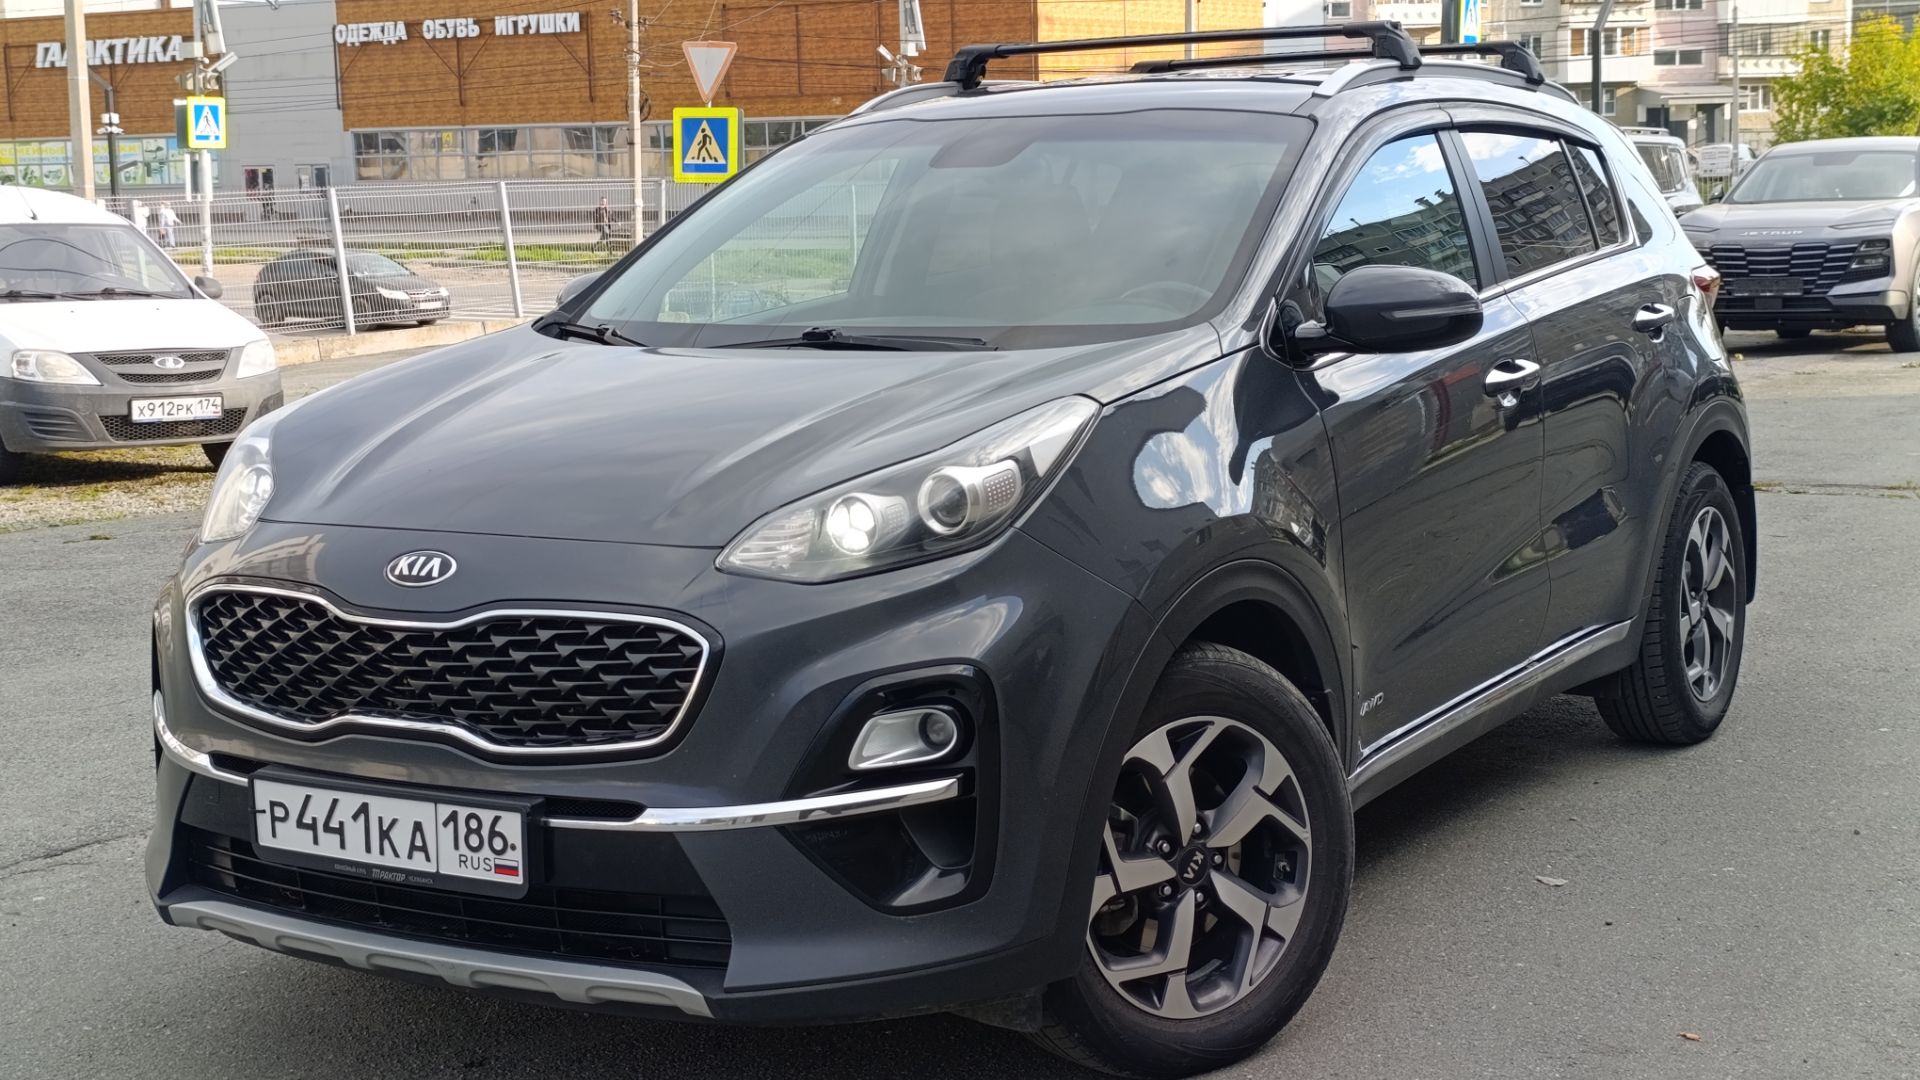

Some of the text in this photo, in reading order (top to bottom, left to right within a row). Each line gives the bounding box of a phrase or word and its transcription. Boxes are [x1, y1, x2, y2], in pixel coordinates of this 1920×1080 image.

[335, 12, 581, 46] ОДЕЖДА ОБУВЬ ИГРУШКИ
[137, 401, 193, 417] Х912РК
[197, 398, 220, 411] 174
[393, 555, 443, 579] KIA
[268, 793, 510, 863] Р441КА 186
[457, 853, 493, 873] RUS
[1183, 850, 1205, 880] KIA
